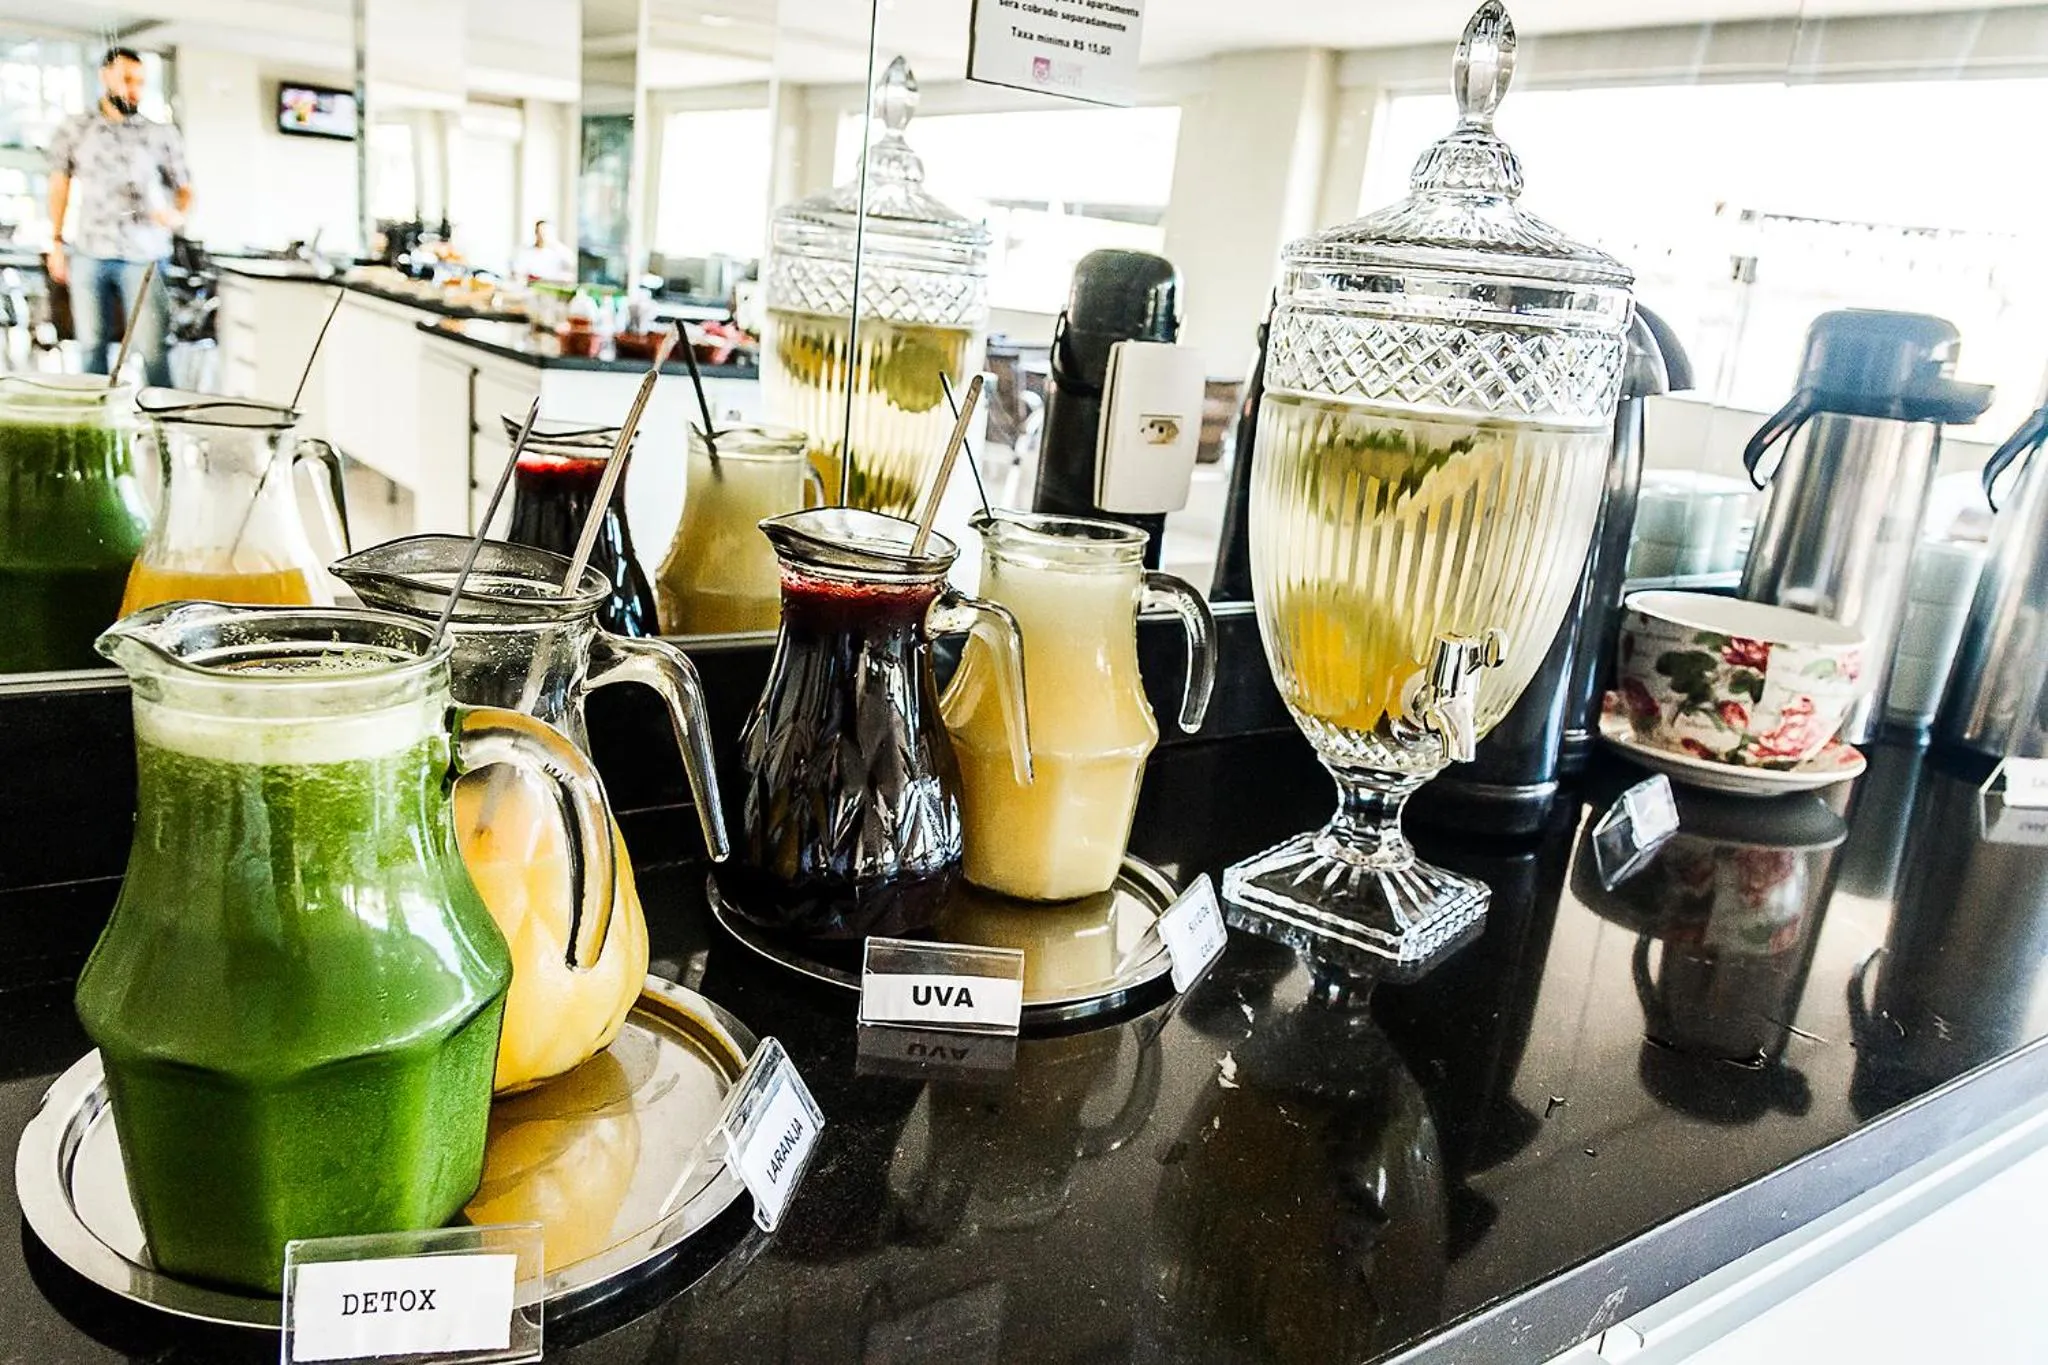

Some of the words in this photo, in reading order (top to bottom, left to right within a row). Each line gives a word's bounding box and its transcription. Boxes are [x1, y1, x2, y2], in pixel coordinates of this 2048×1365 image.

[1021, 3, 1059, 18] cobrado
[1061, 12, 1126, 32] separadamente
[1012, 26, 1034, 40] Taxa
[1073, 39, 1084, 51] R$
[912, 985, 974, 1008] UVA
[766, 1117, 804, 1185] LARANJA
[341, 1289, 437, 1316] DETOX
